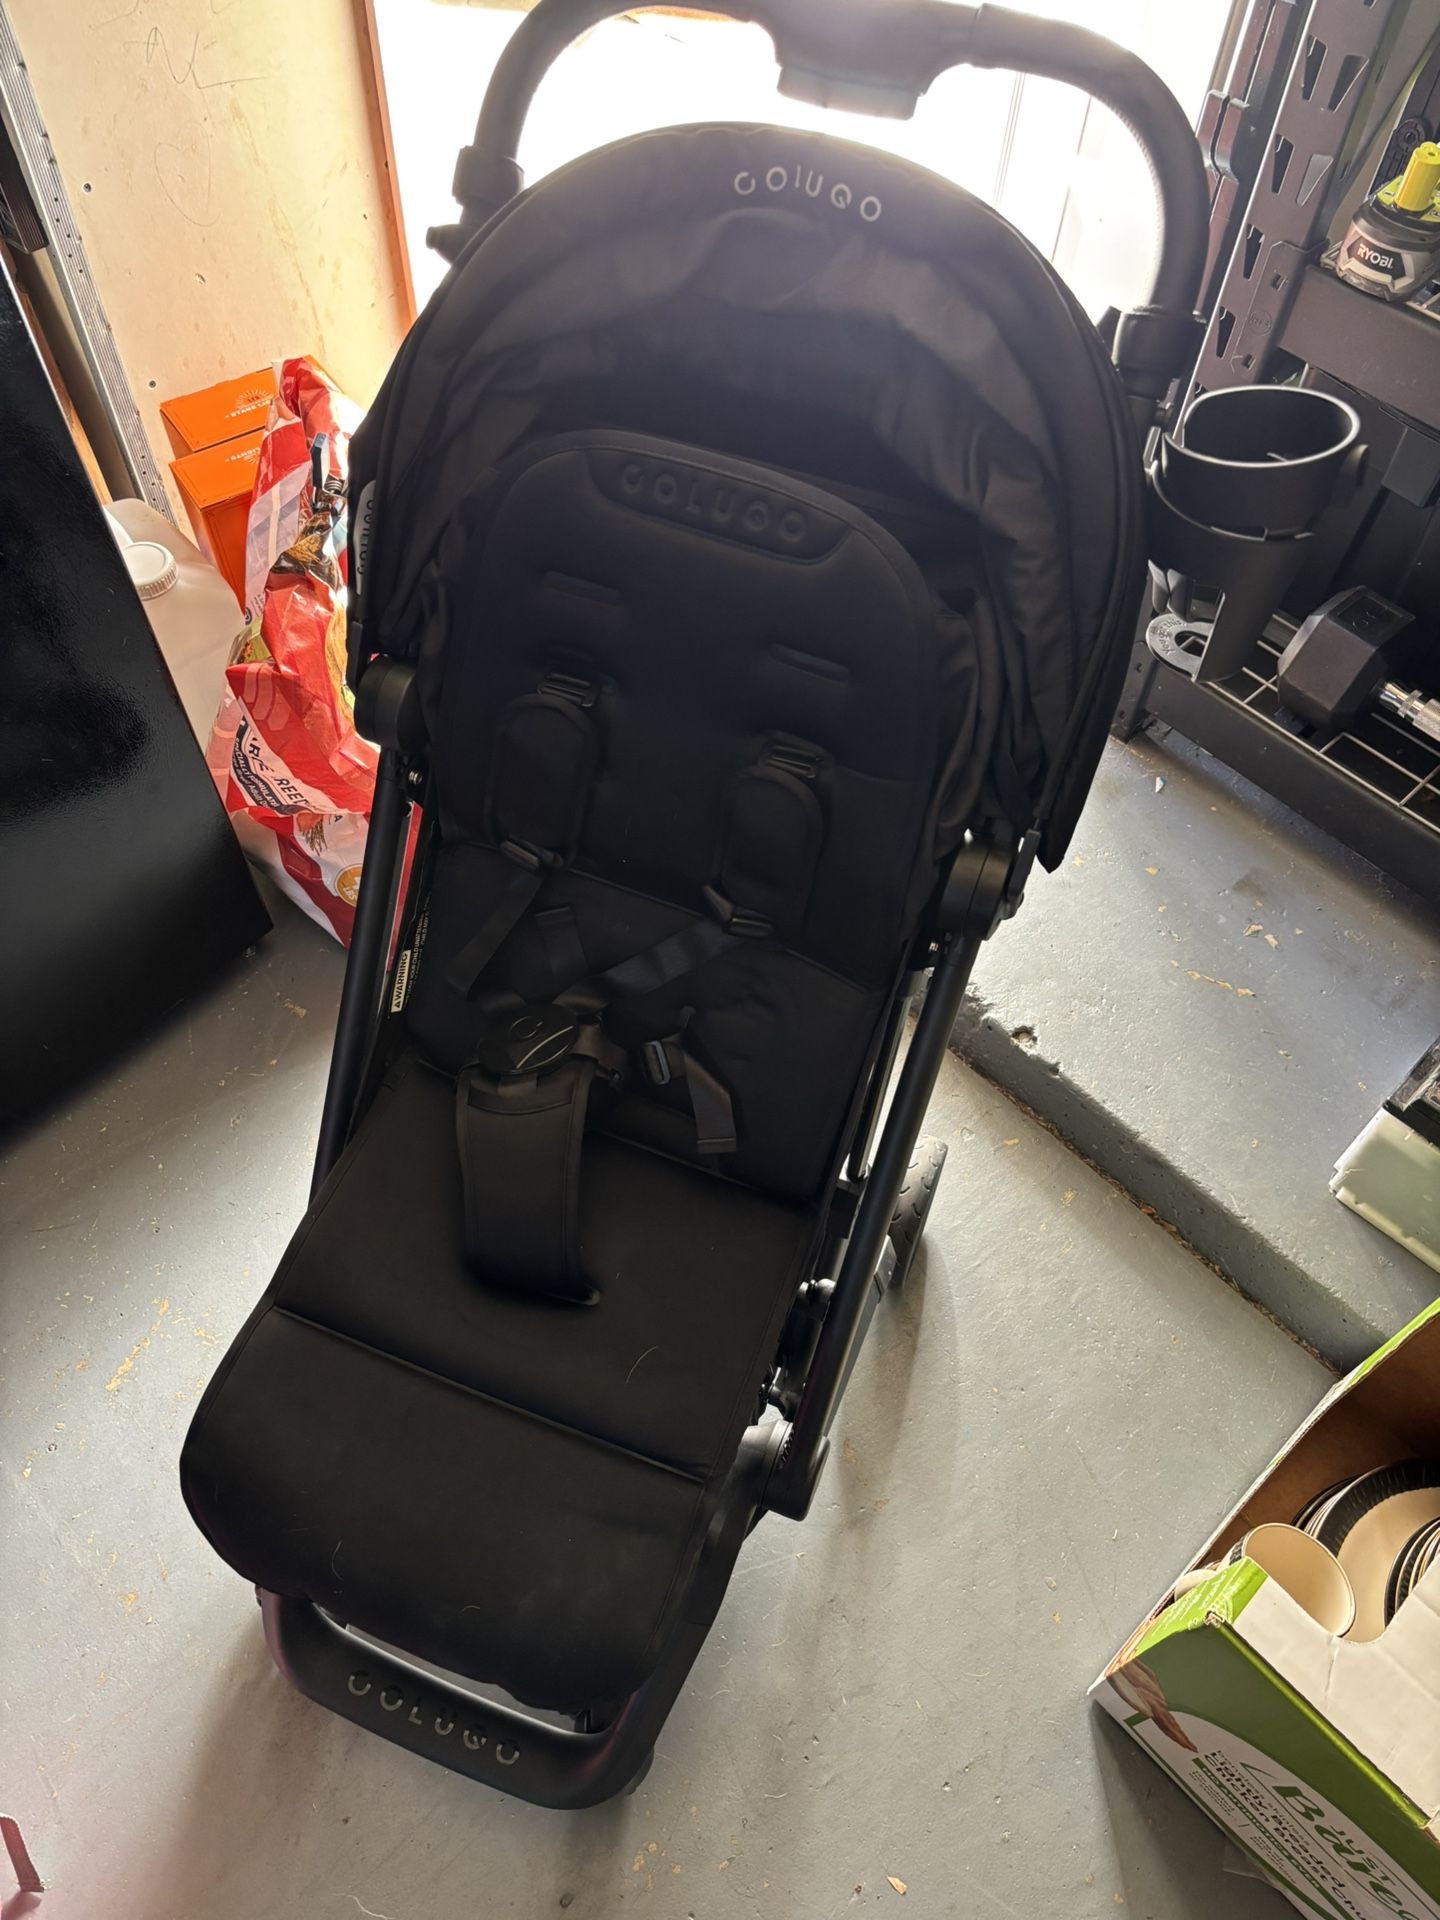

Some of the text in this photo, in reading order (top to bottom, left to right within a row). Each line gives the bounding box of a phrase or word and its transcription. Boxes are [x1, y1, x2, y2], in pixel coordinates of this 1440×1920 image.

[1356, 243, 1394, 269] RYOBI
[394, 952, 409, 1002] WARNING
[1204, 1754, 1270, 1823] Chicken
[1273, 1827, 1329, 1882] Breast
[1210, 1752, 1269, 1810] Lightly
[1271, 1814, 1346, 1888] Breaded
[1271, 1785, 1403, 1907] Bare
[1329, 1824, 1397, 1887] JUST
